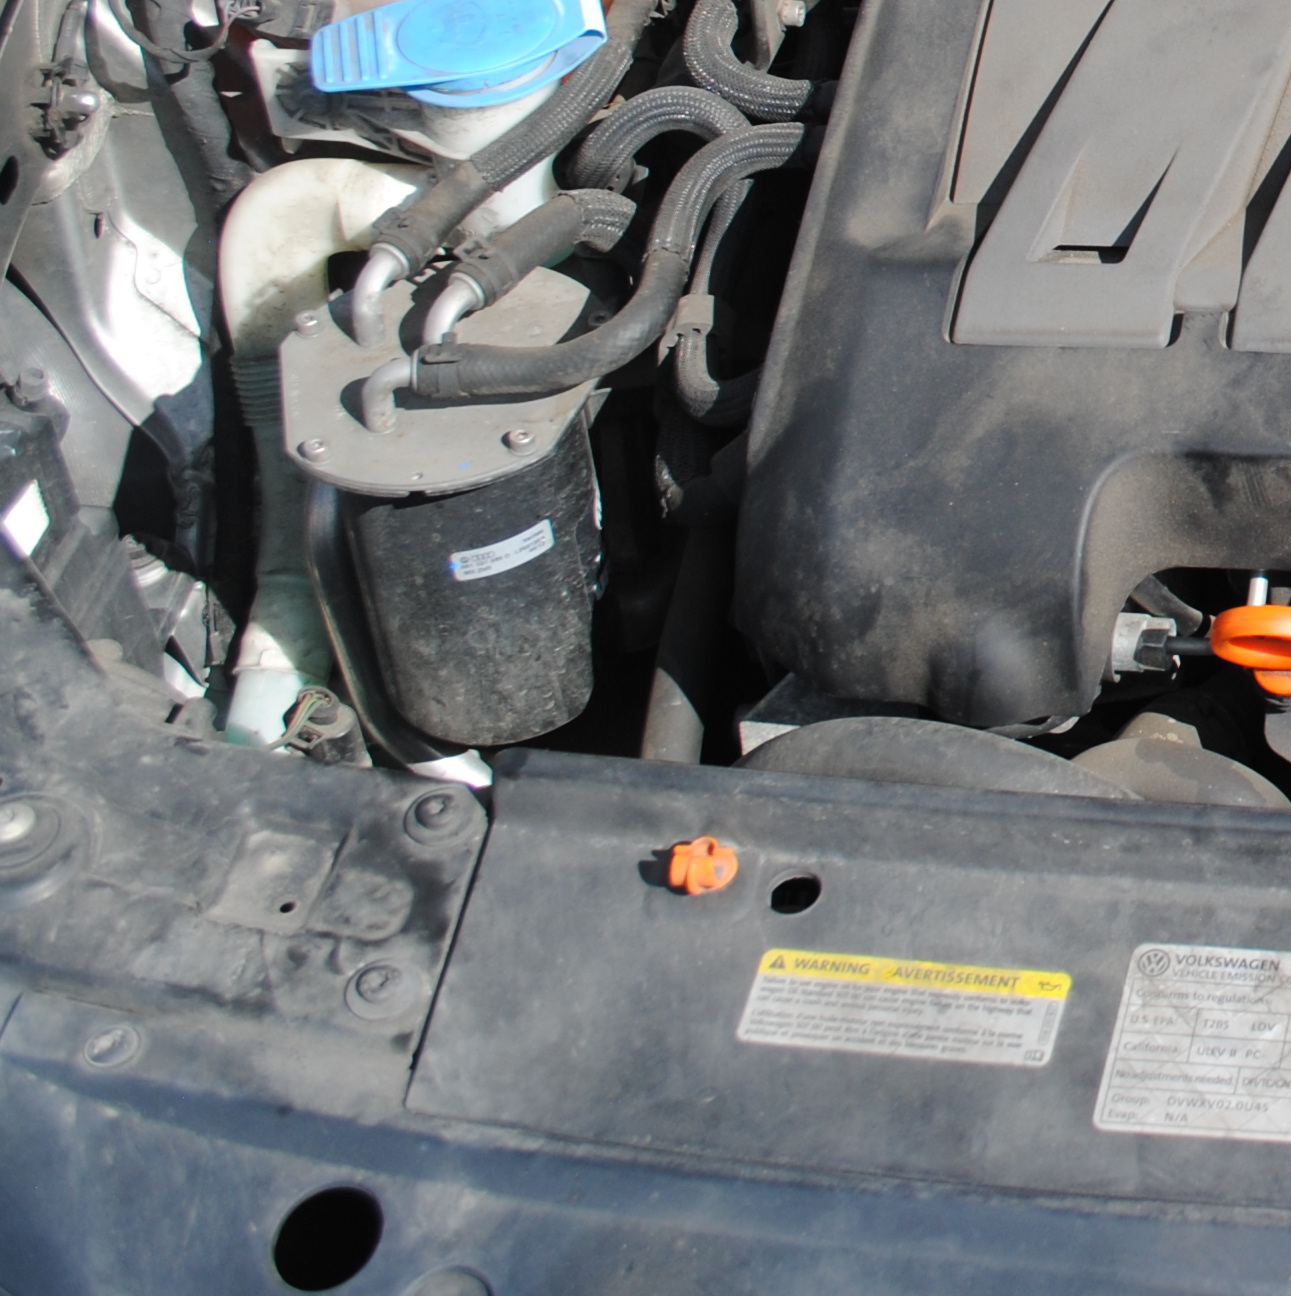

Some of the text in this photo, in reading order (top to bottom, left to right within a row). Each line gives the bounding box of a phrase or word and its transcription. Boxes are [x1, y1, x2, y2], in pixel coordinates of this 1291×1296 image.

[1172, 953, 1281, 972] VOLKSWAGEN
[794, 957, 1020, 989] WARNING AVERTISSEMENT
[1170, 967, 1218, 980] VEHICLE
[1219, 970, 1276, 984] EMISSION
[1250, 1021, 1276, 1032] LDV
[1162, 1112, 1190, 1123] N/A
